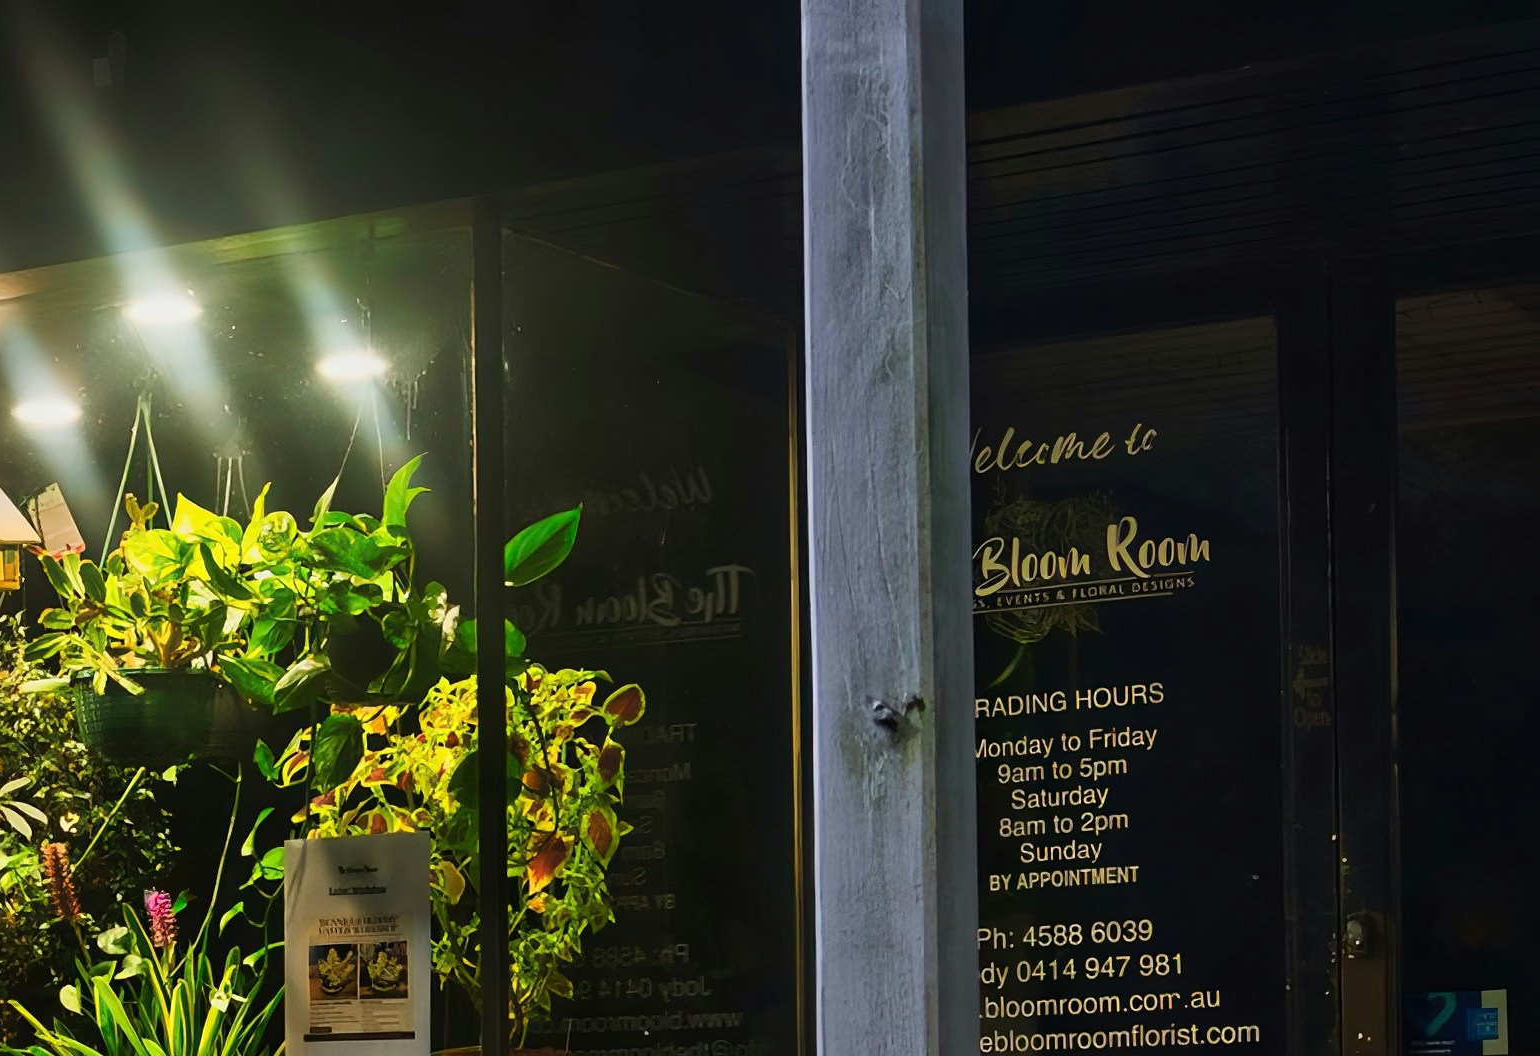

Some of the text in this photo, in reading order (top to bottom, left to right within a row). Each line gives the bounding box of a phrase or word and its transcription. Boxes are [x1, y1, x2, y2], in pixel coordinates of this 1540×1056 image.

[971, 423, 1158, 474] elcome to
[972, 516, 1210, 597] Bloom Room
[996, 592, 1050, 608] EVENTS
[1072, 584, 1125, 599] FLORAL
[1131, 576, 1195, 593] DESIGNS
[1075, 682, 1165, 711] HOURS
[1061, 732, 1082, 752] to
[1089, 726, 1158, 750] Friday
[997, 757, 1128, 784] 9am to 5pm
[1011, 785, 1109, 810] Saturday
[999, 812, 1129, 838] 8am to 2pm
[1020, 839, 1103, 864] Sunday
[989, 865, 1140, 892] BY APPOINTMENT
[976, 919, 1153, 950] Ph: 4588 6039
[979, 953, 1183, 990] dy 0414 947 981
